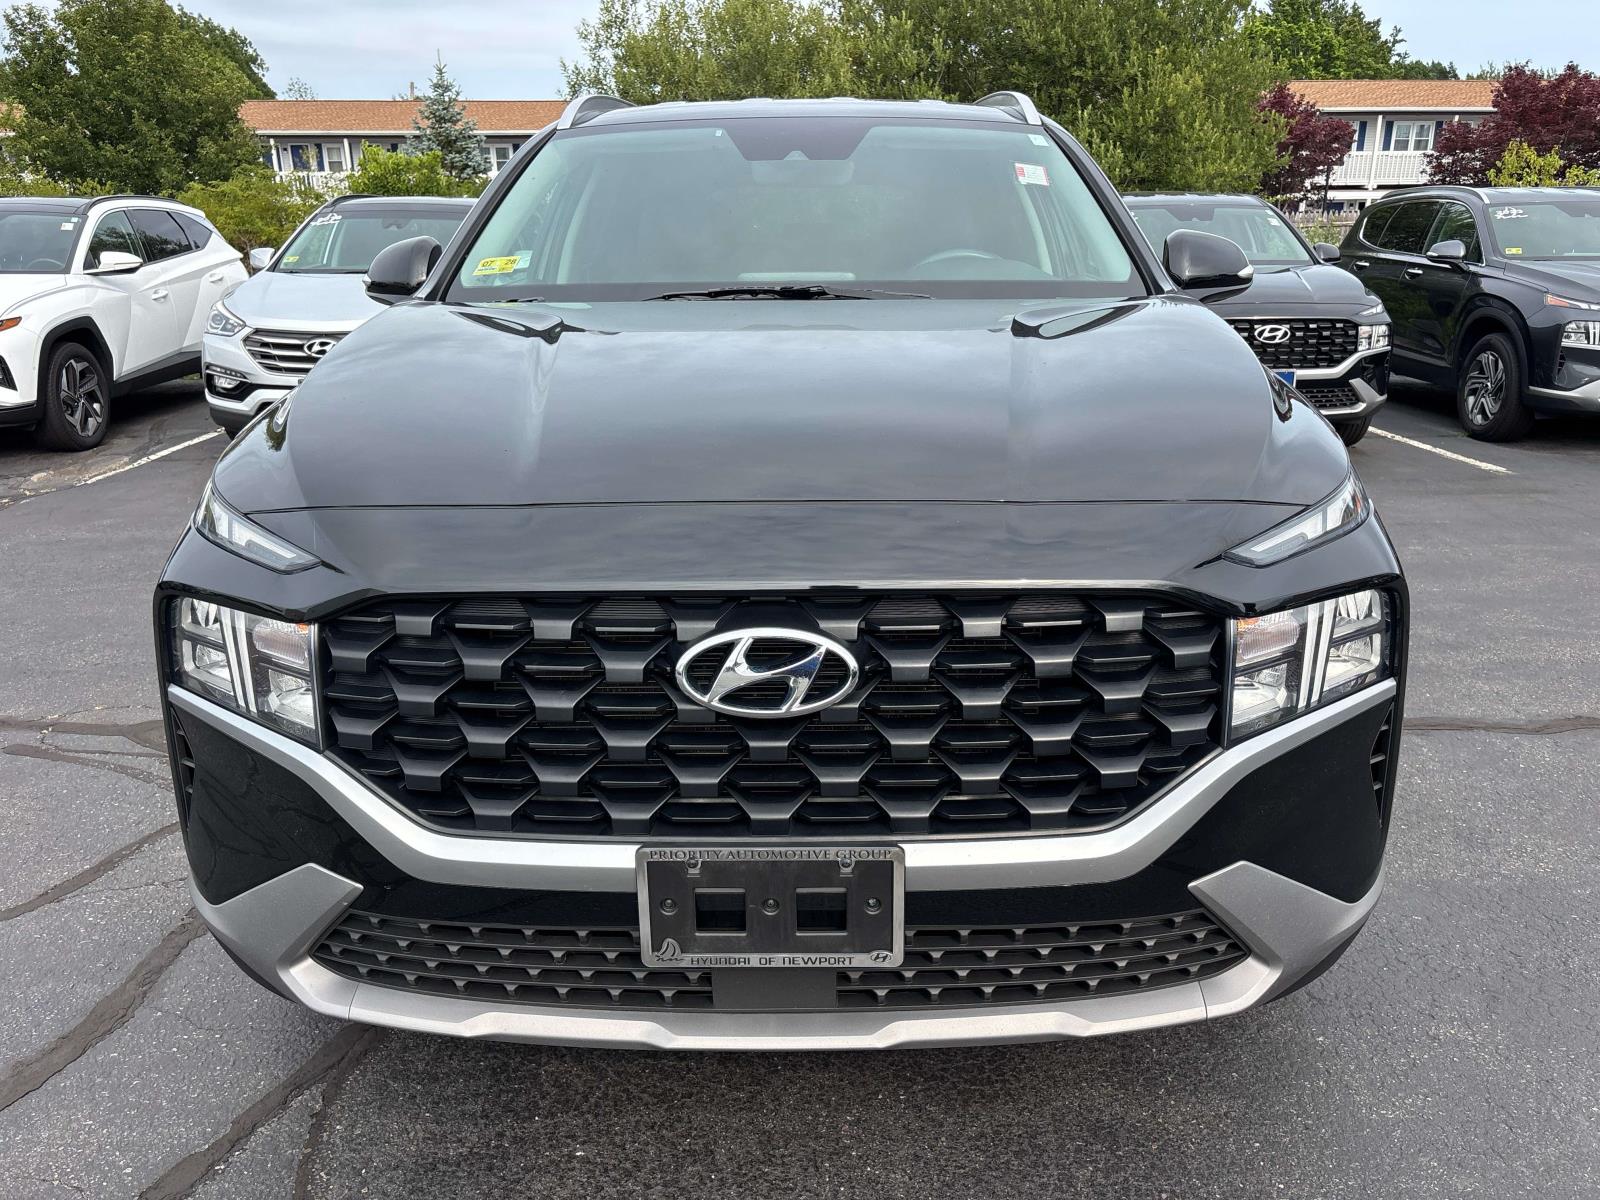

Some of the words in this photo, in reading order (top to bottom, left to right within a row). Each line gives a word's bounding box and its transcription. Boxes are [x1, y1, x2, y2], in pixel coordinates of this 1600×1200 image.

[649, 849, 722, 860] PRIORITY
[727, 849, 831, 860] AUTOMOTIVE
[835, 849, 892, 860] GROUP
[690, 956, 751, 966] HYUNDAI
[758, 956, 777, 966] OF
[782, 956, 856, 966] NEWPORT
